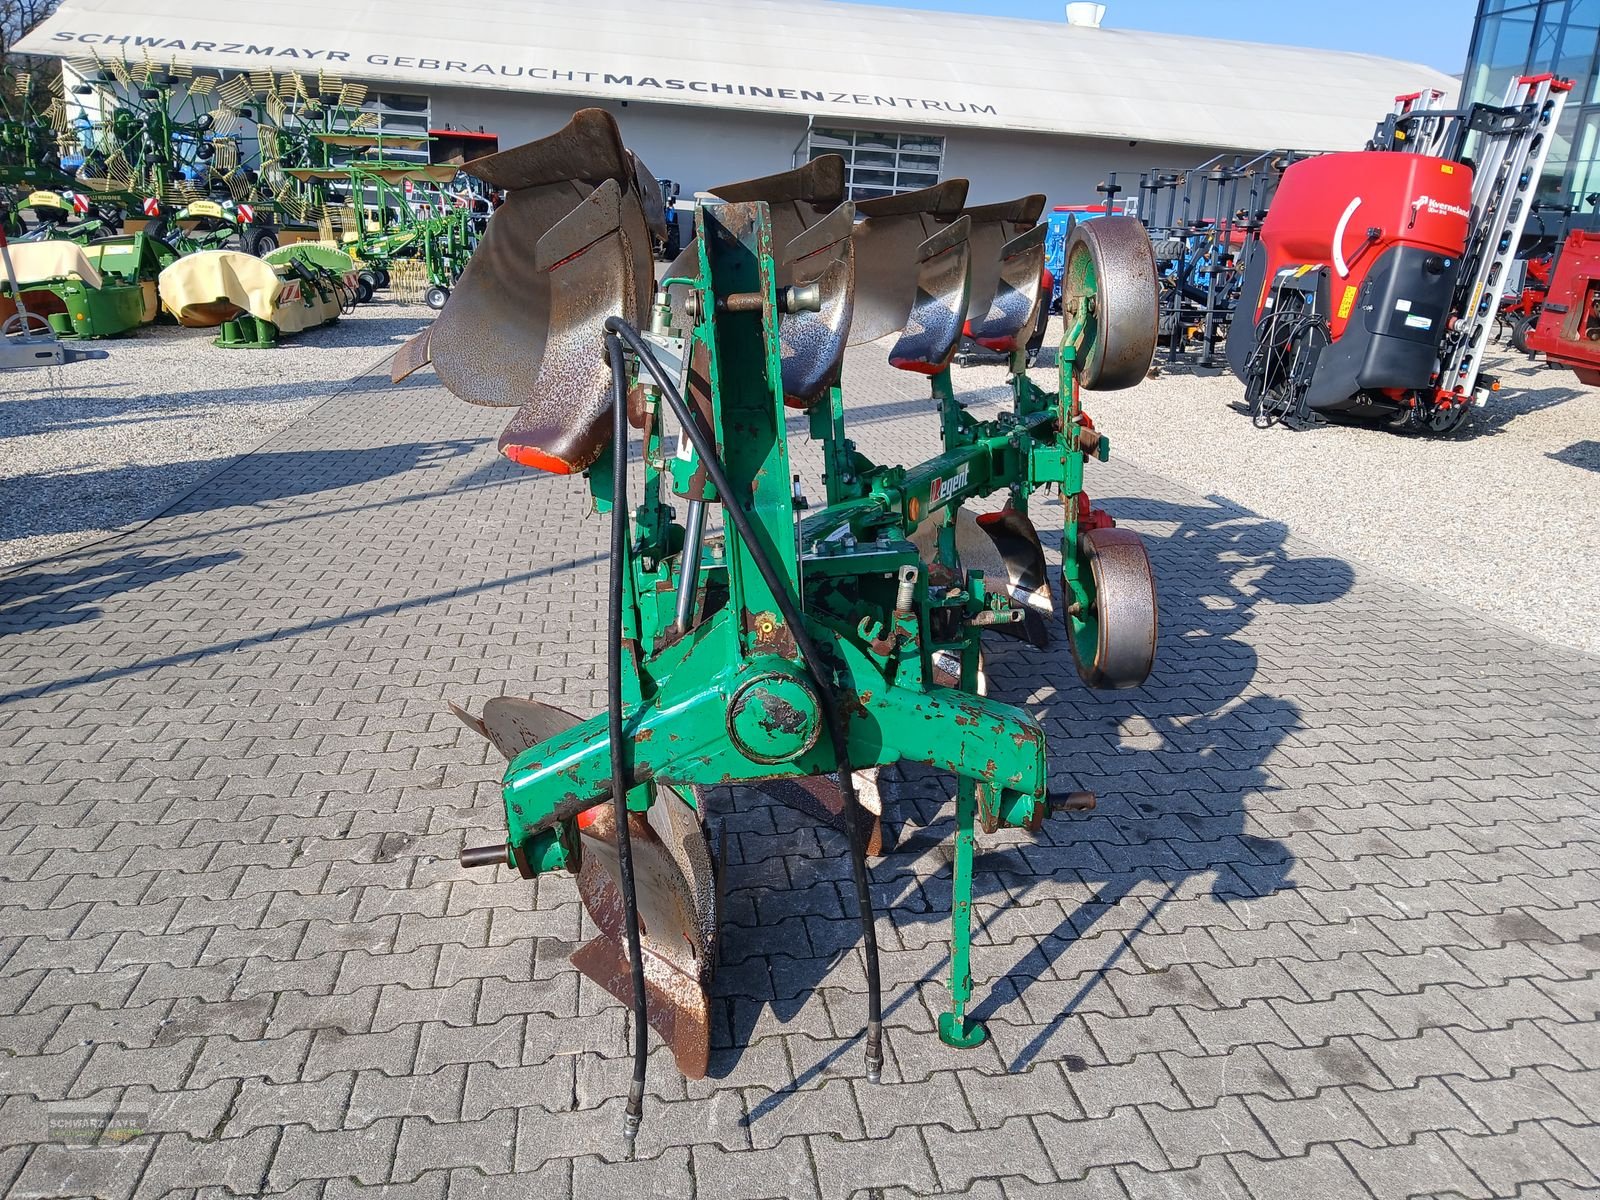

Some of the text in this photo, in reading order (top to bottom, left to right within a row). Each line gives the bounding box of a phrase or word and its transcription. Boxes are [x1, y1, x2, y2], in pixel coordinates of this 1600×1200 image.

[51, 31, 997, 115] SCHWARZMAYR GEBRAUCHTMASCHINENZENTRUM
[1428, 198, 1470, 218] Kverneland
[930, 462, 969, 504] Regent
